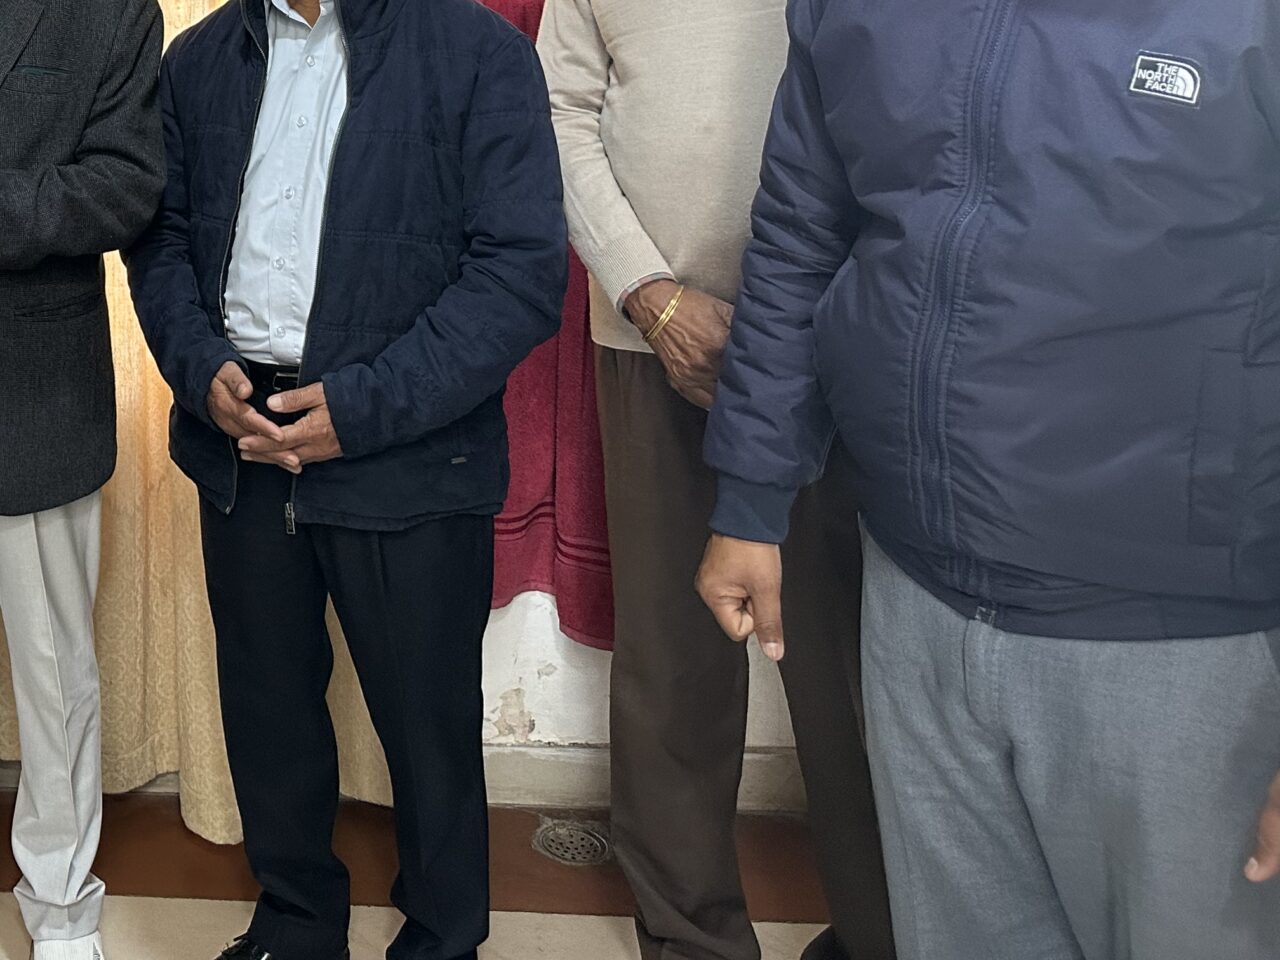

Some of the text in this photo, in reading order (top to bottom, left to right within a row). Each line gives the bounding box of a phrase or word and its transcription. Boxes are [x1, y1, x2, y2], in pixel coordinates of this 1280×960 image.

[1156, 63, 1179, 75] THE
[1137, 69, 1177, 84] NORTH
[1144, 80, 1175, 93] FACE
